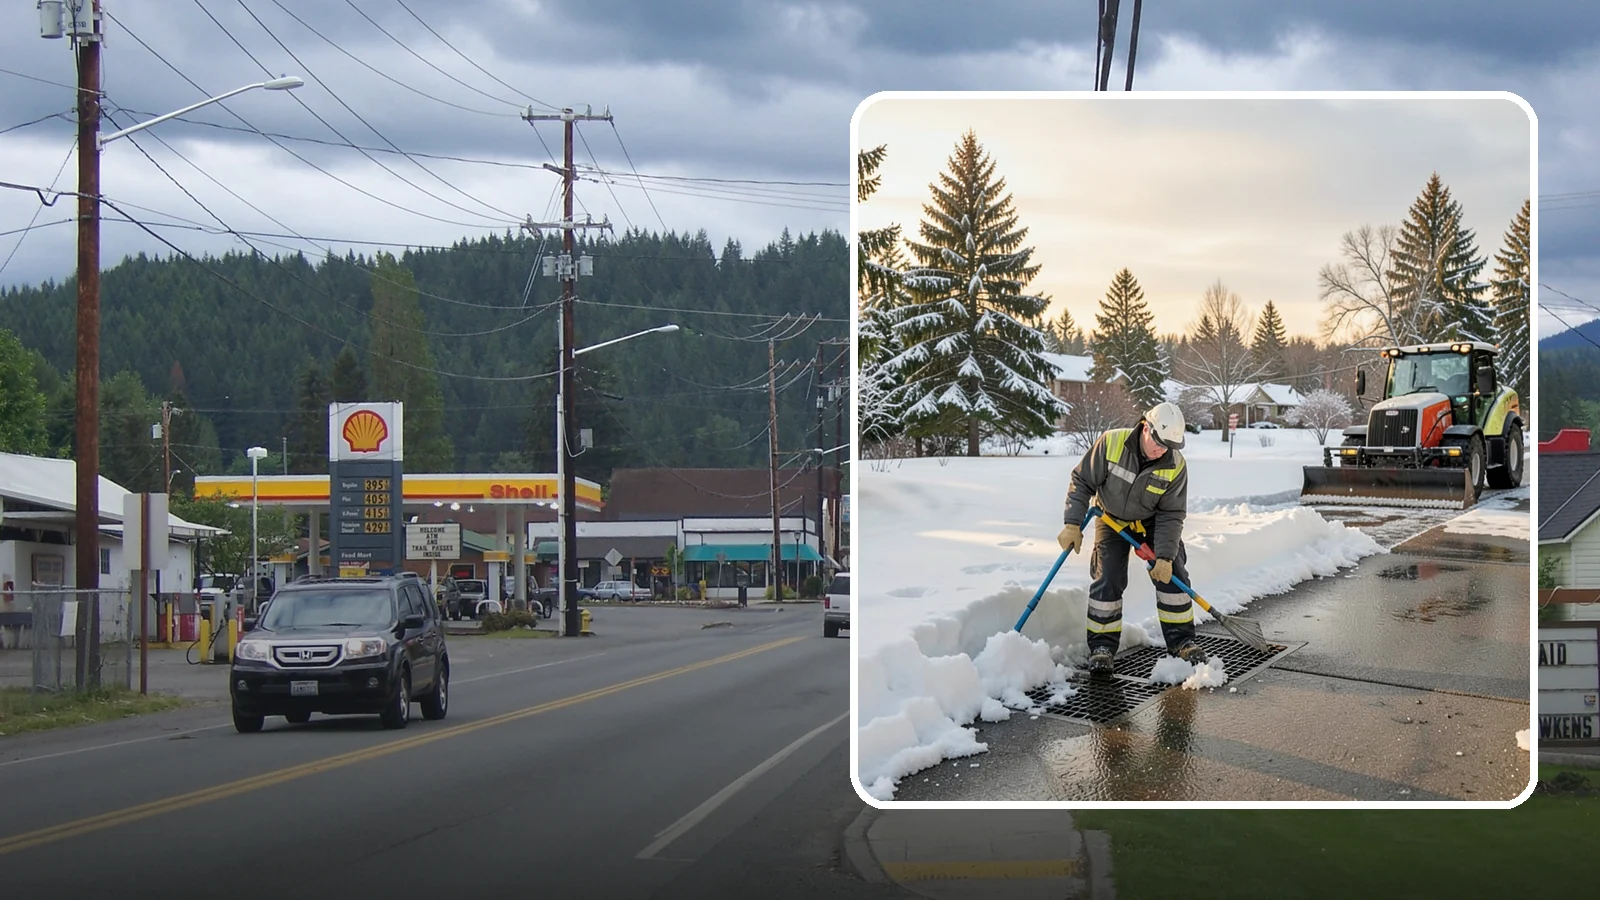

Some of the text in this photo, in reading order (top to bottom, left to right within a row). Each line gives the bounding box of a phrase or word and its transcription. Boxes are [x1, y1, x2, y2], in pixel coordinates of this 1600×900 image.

[366, 480, 384, 490] 395
[490, 484, 548, 499] Shell
[365, 494, 384, 504] 405
[365, 508, 383, 518] 415
[365, 522, 384, 532] 429
[1538, 643, 1566, 665] AID
